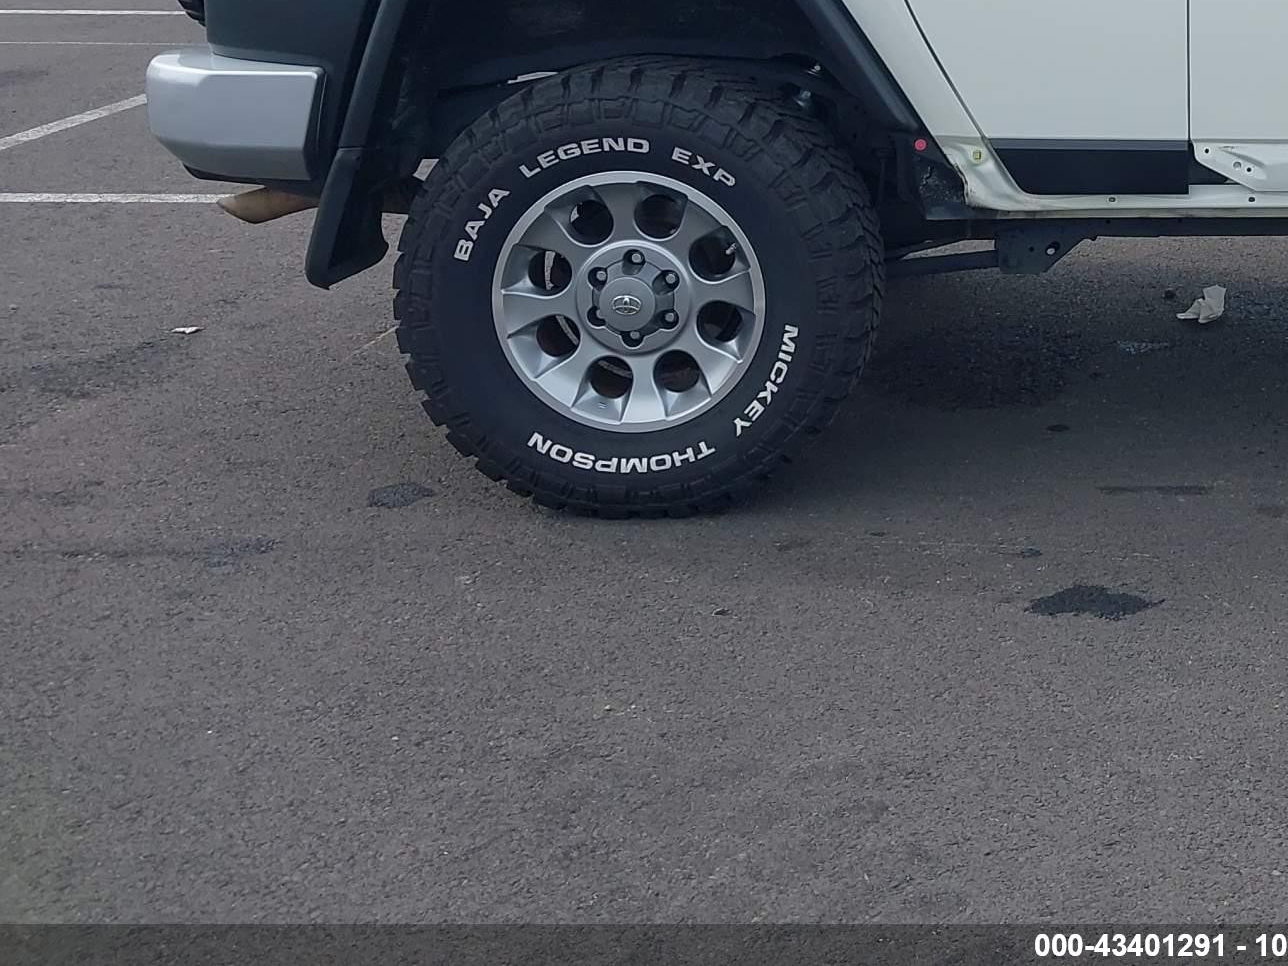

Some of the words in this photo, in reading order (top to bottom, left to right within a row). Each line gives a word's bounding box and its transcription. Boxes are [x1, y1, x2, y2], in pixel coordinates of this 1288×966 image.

[453, 187, 511, 262] BAJA
[518, 136, 651, 179] LEGEND
[671, 146, 736, 188] EXP
[732, 324, 799, 437] MICKEY
[526, 430, 716, 474] THOMPSON
